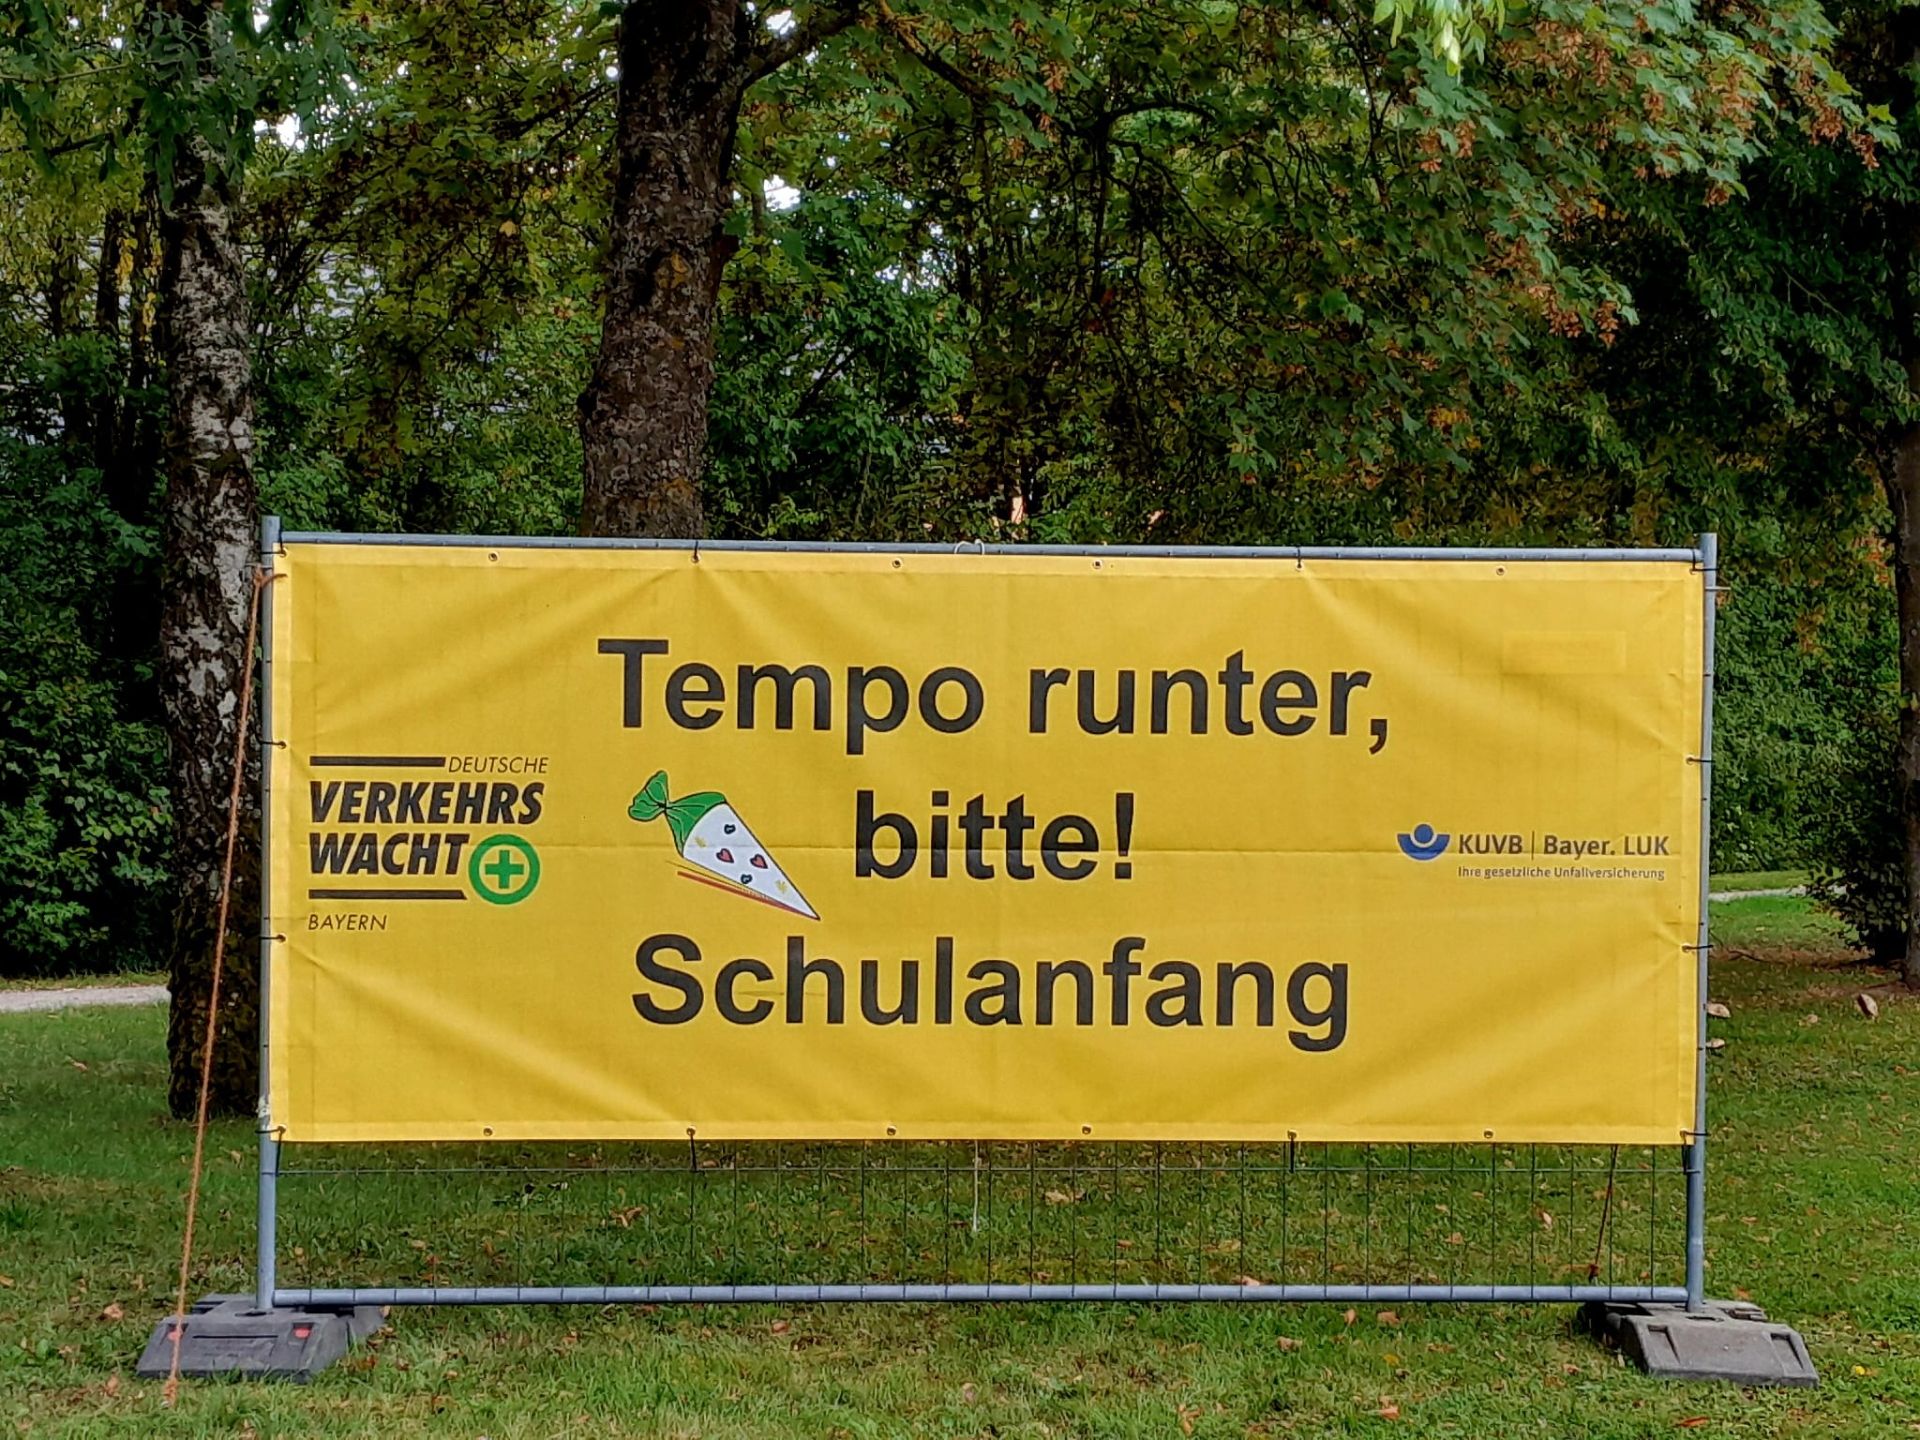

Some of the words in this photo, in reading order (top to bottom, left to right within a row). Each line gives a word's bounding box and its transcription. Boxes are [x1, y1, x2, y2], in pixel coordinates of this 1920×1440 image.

[597, 637, 985, 755] Tempo
[1028, 649, 1388, 755] runter,
[448, 757, 549, 774] DEUTSCHE
[309, 781, 545, 825] VERKEHRS
[309, 832, 470, 875] WACHT
[854, 790, 1136, 881] bitte!
[1458, 834, 1523, 855] KUVB
[1543, 834, 1616, 860] Bayer.
[1623, 835, 1670, 856] LUK
[1458, 866, 1481, 878] Ihre
[1484, 866, 1551, 880] gesetzliche
[1554, 866, 1666, 881] Unfallversicherung
[308, 914, 388, 931] BAYERN
[631, 933, 1349, 1053] Schulanfang
